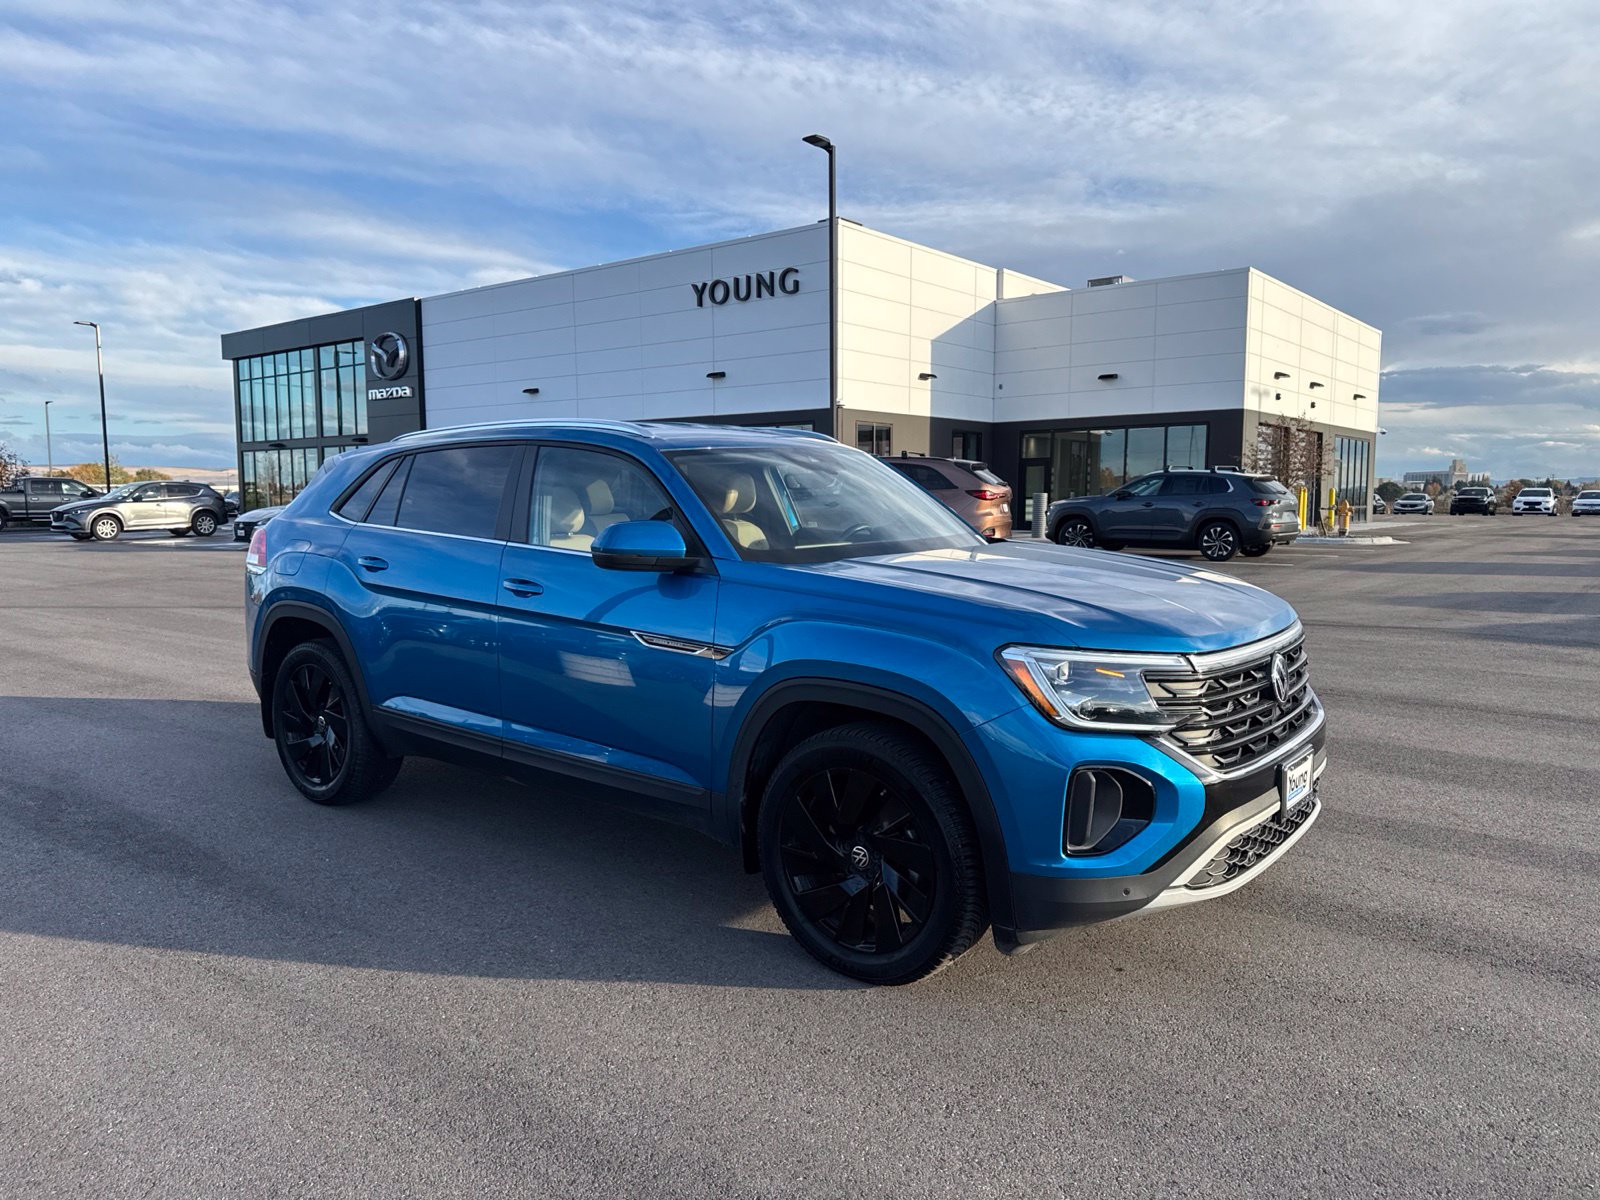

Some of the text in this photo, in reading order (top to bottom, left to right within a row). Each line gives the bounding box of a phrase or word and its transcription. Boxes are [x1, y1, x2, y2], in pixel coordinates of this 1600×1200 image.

[691, 267, 800, 308] YOUNG
[368, 386, 412, 401] mazda
[1288, 770, 1308, 793] Young
